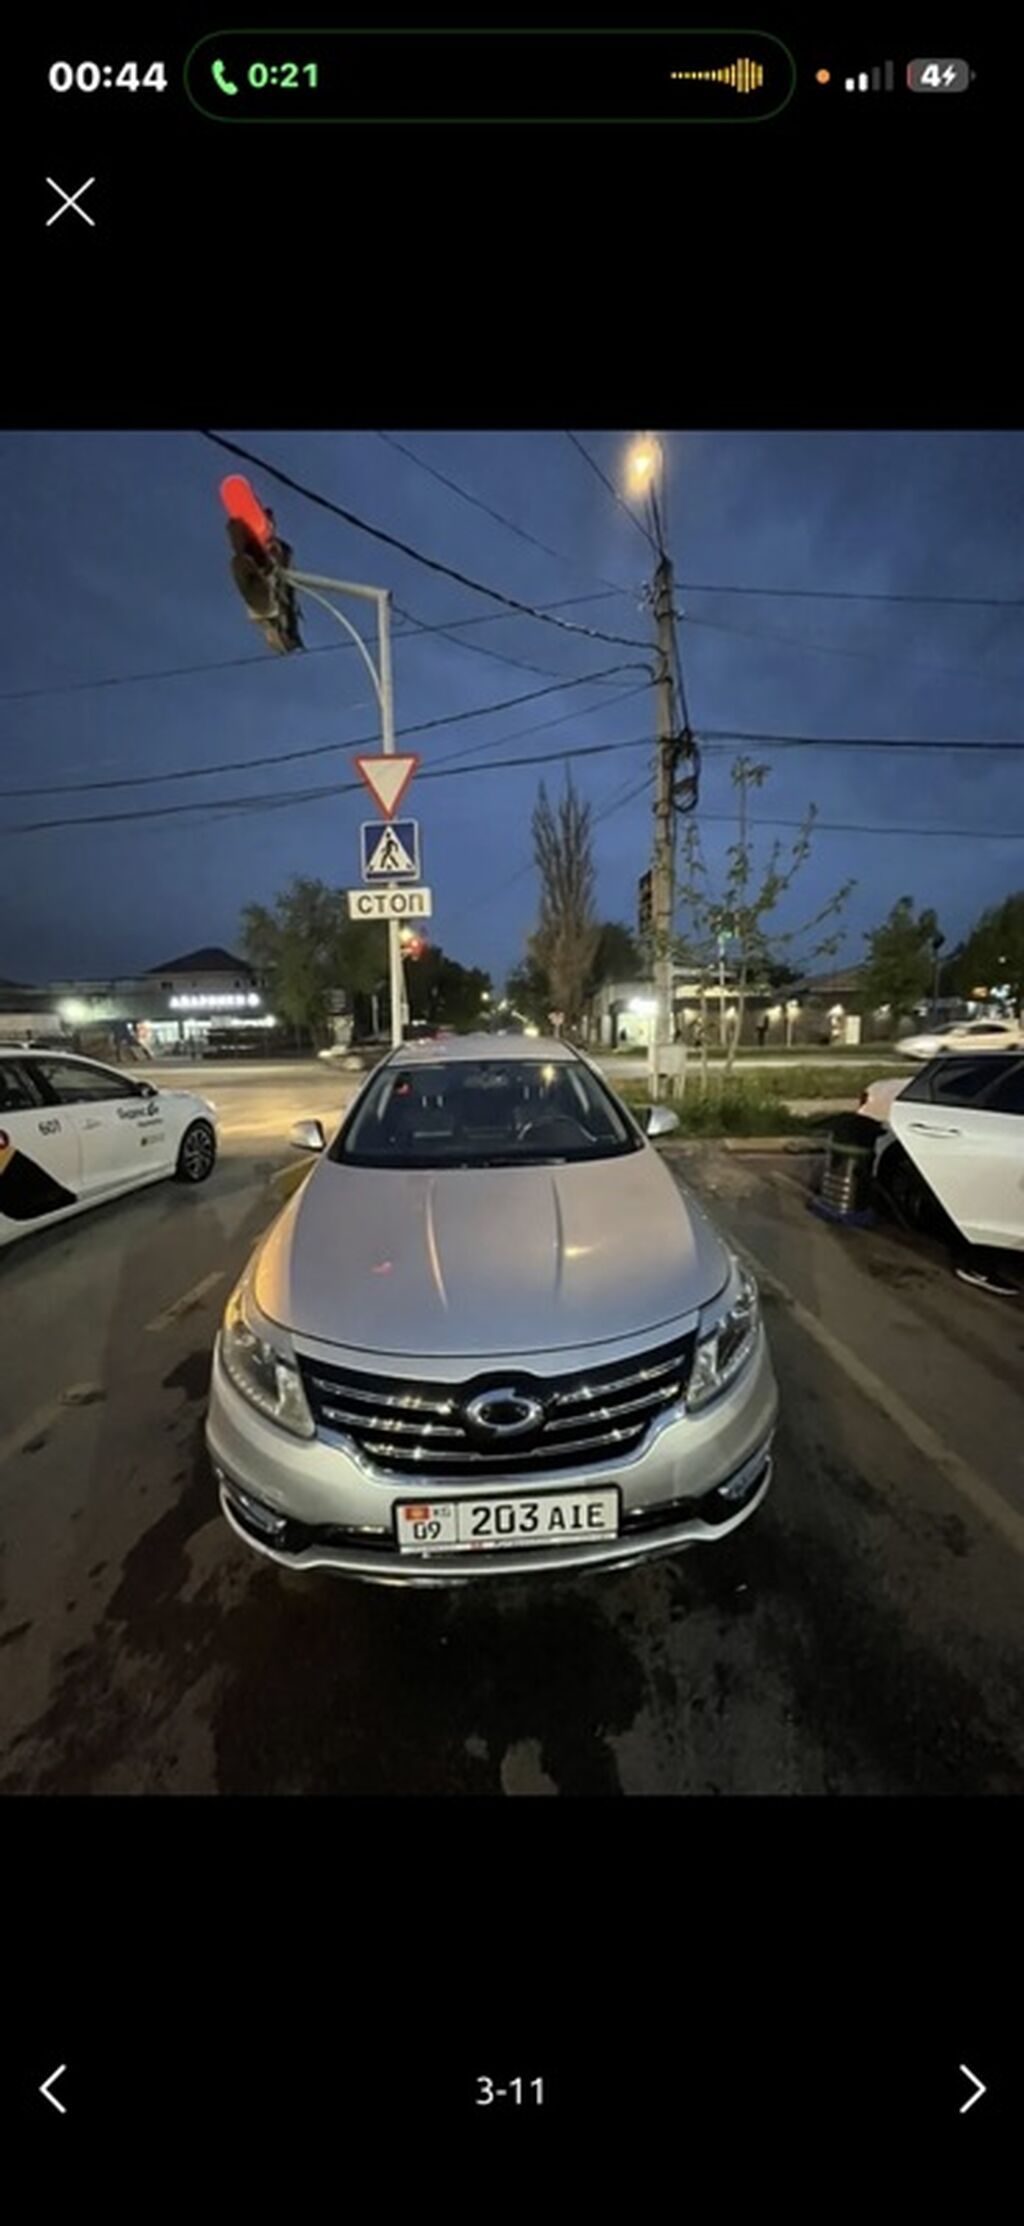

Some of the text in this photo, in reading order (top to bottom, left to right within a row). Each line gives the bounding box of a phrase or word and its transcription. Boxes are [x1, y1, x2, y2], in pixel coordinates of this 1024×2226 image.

[358, 894, 423, 914] СТОП
[471, 1502, 606, 1536] 203 AIE
[413, 1520, 442, 1540] 09
